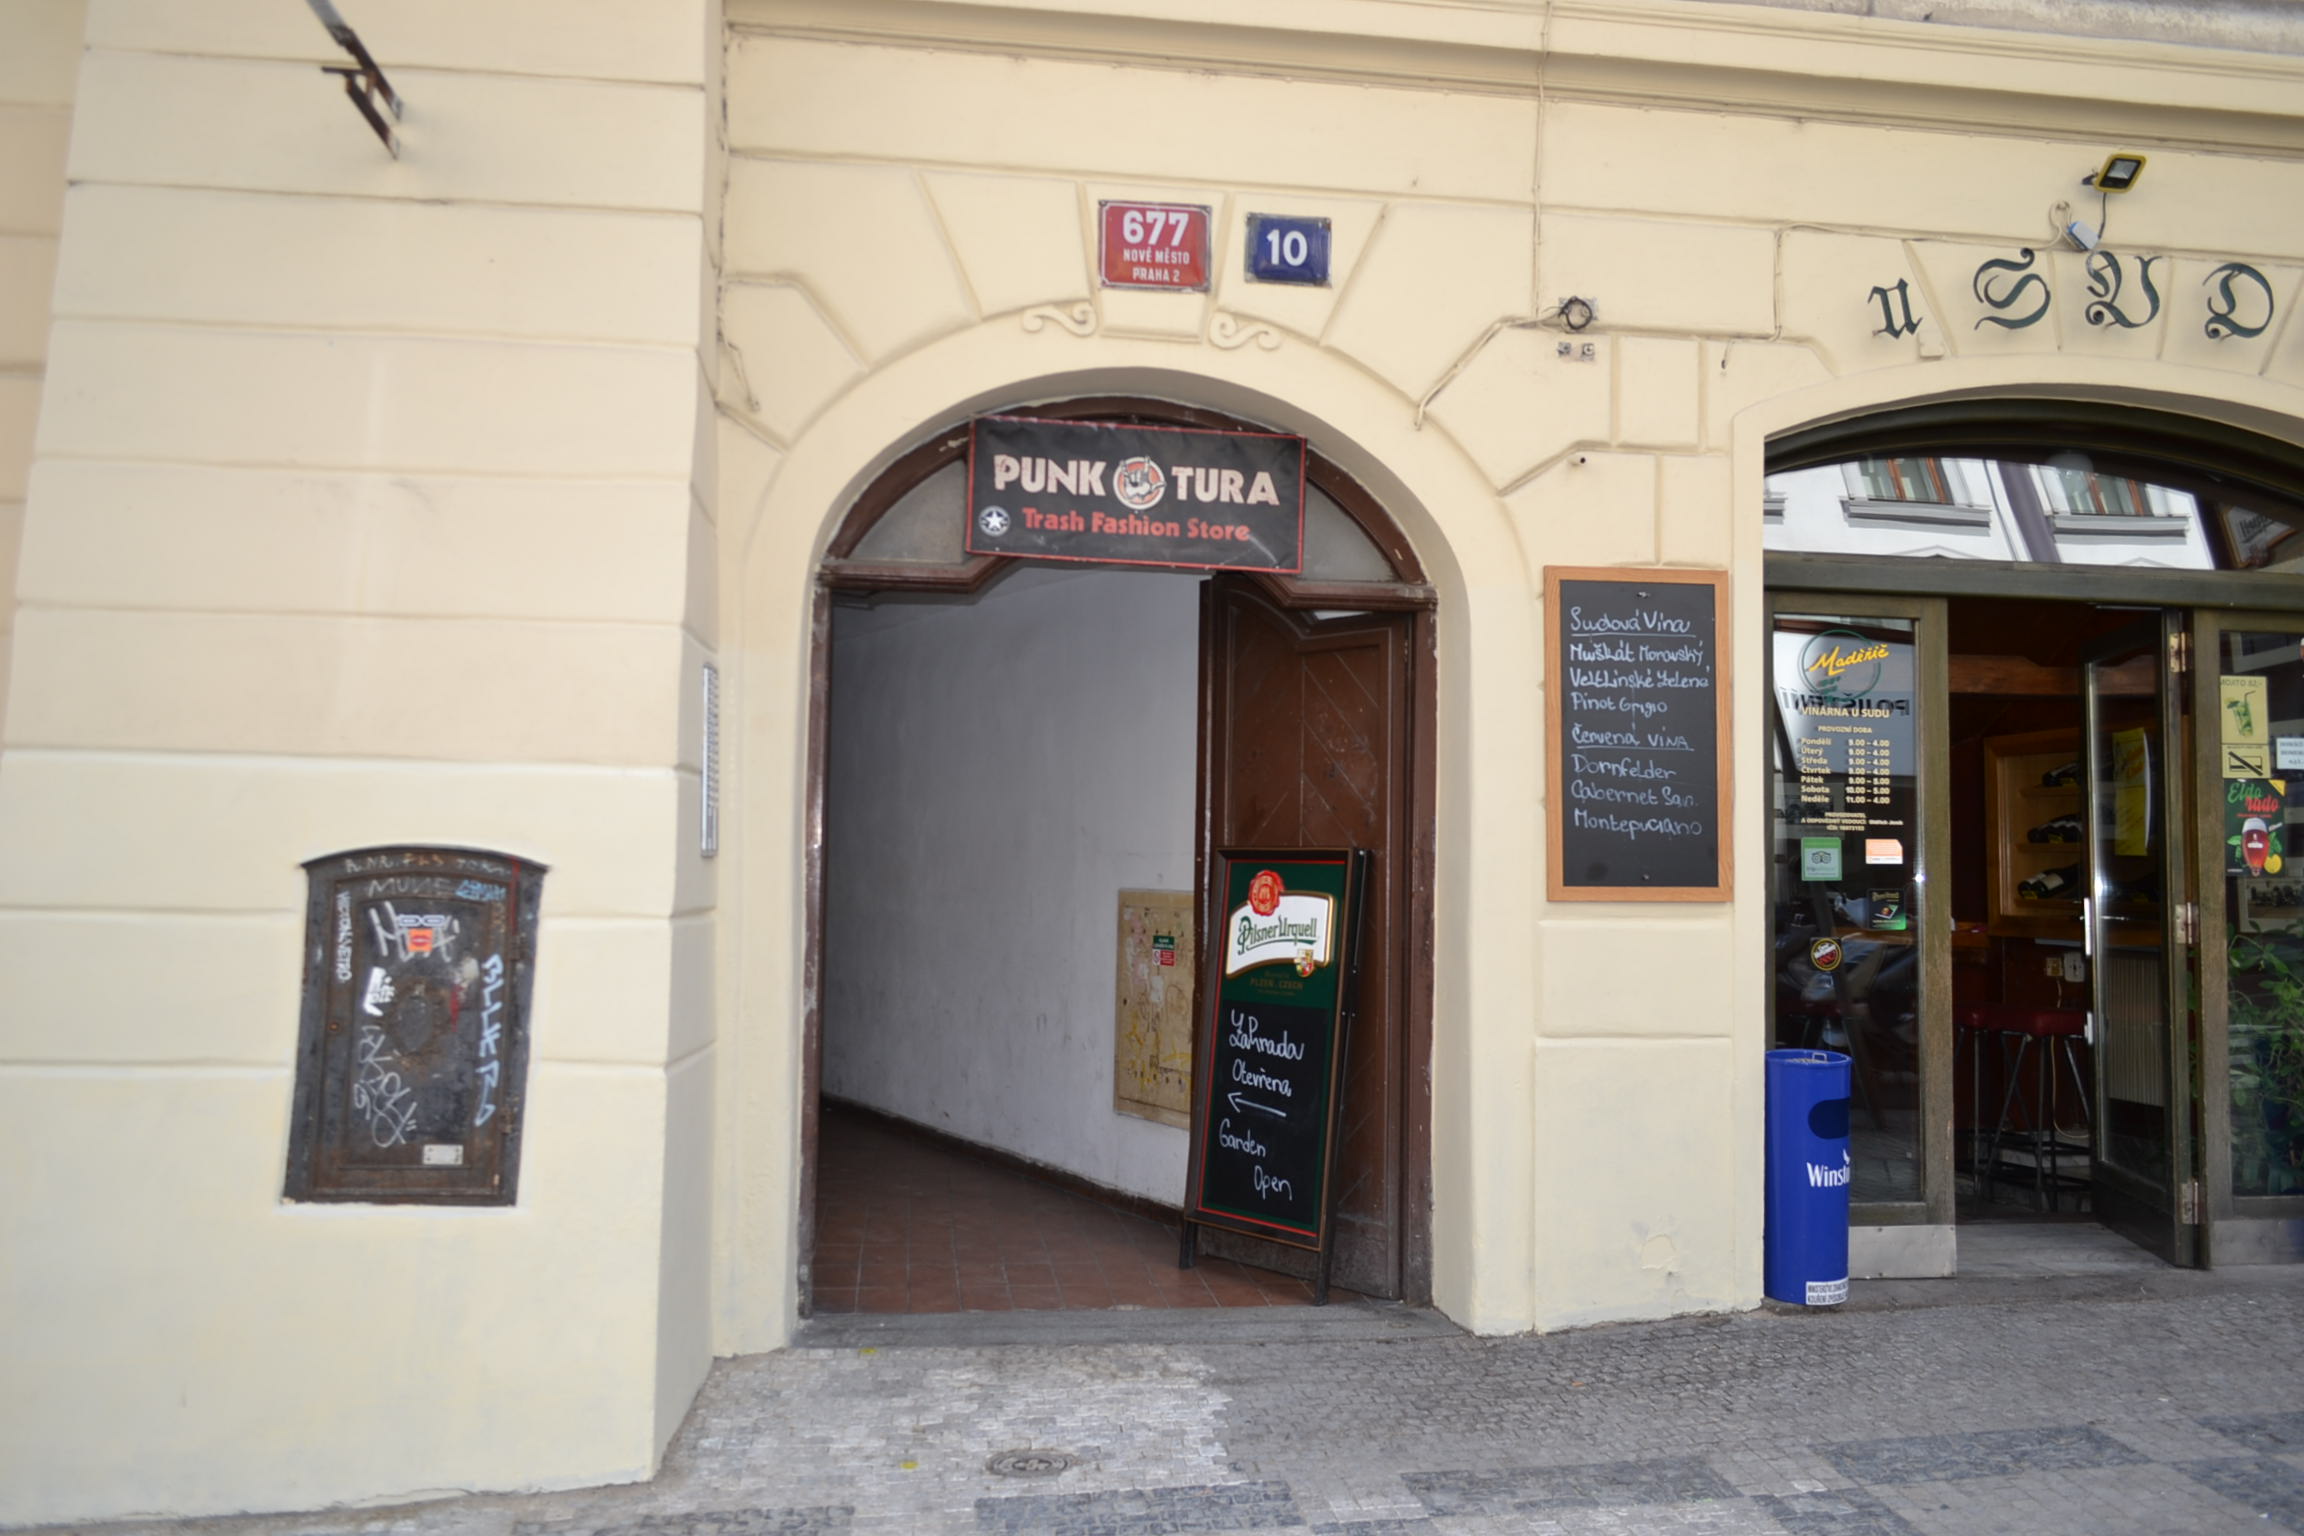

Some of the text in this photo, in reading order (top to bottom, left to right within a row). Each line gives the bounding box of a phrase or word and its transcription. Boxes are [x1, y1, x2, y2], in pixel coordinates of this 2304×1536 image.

[1123, 211, 1189, 247] 677
[1123, 247, 1190, 264] NOVÉ MĚSTO
[1266, 229, 1308, 266] 10
[1132, 267, 1180, 282] PRAHA 2
[993, 454, 1280, 505] PUNK TURA
[1022, 507, 1249, 541] Trash Fashion Store
[1571, 691, 1616, 713] Pinot
[1851, 708, 1860, 718] U
[1861, 708, 1890, 718] SUDU
[1571, 754, 1677, 780] Dornfelder
[1571, 779, 1659, 805] Cabernet
[1219, 1118, 1266, 1157] Garden
[1254, 1165, 1293, 1201] Open
